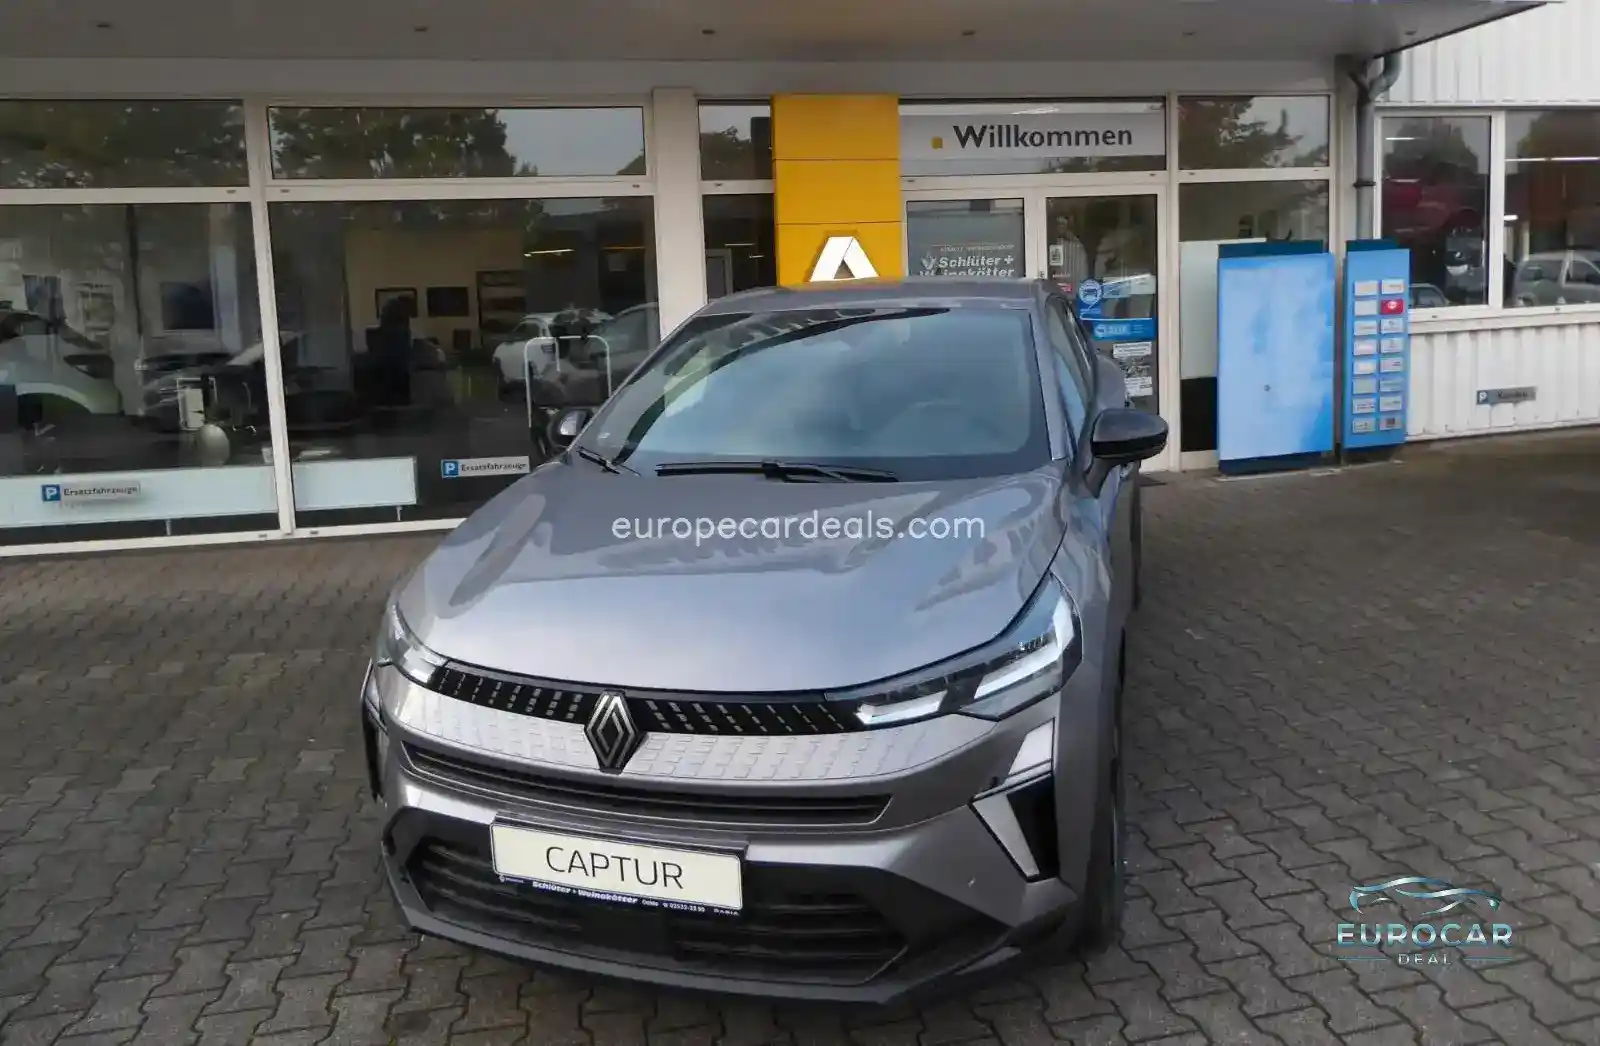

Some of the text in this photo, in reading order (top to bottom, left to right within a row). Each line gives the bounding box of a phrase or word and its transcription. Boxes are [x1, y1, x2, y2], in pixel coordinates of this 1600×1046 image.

[953, 124, 1132, 149] Willkommen
[63, 486, 138, 496] Ersatzfahrzeuge
[546, 846, 684, 890] CAPTUR
